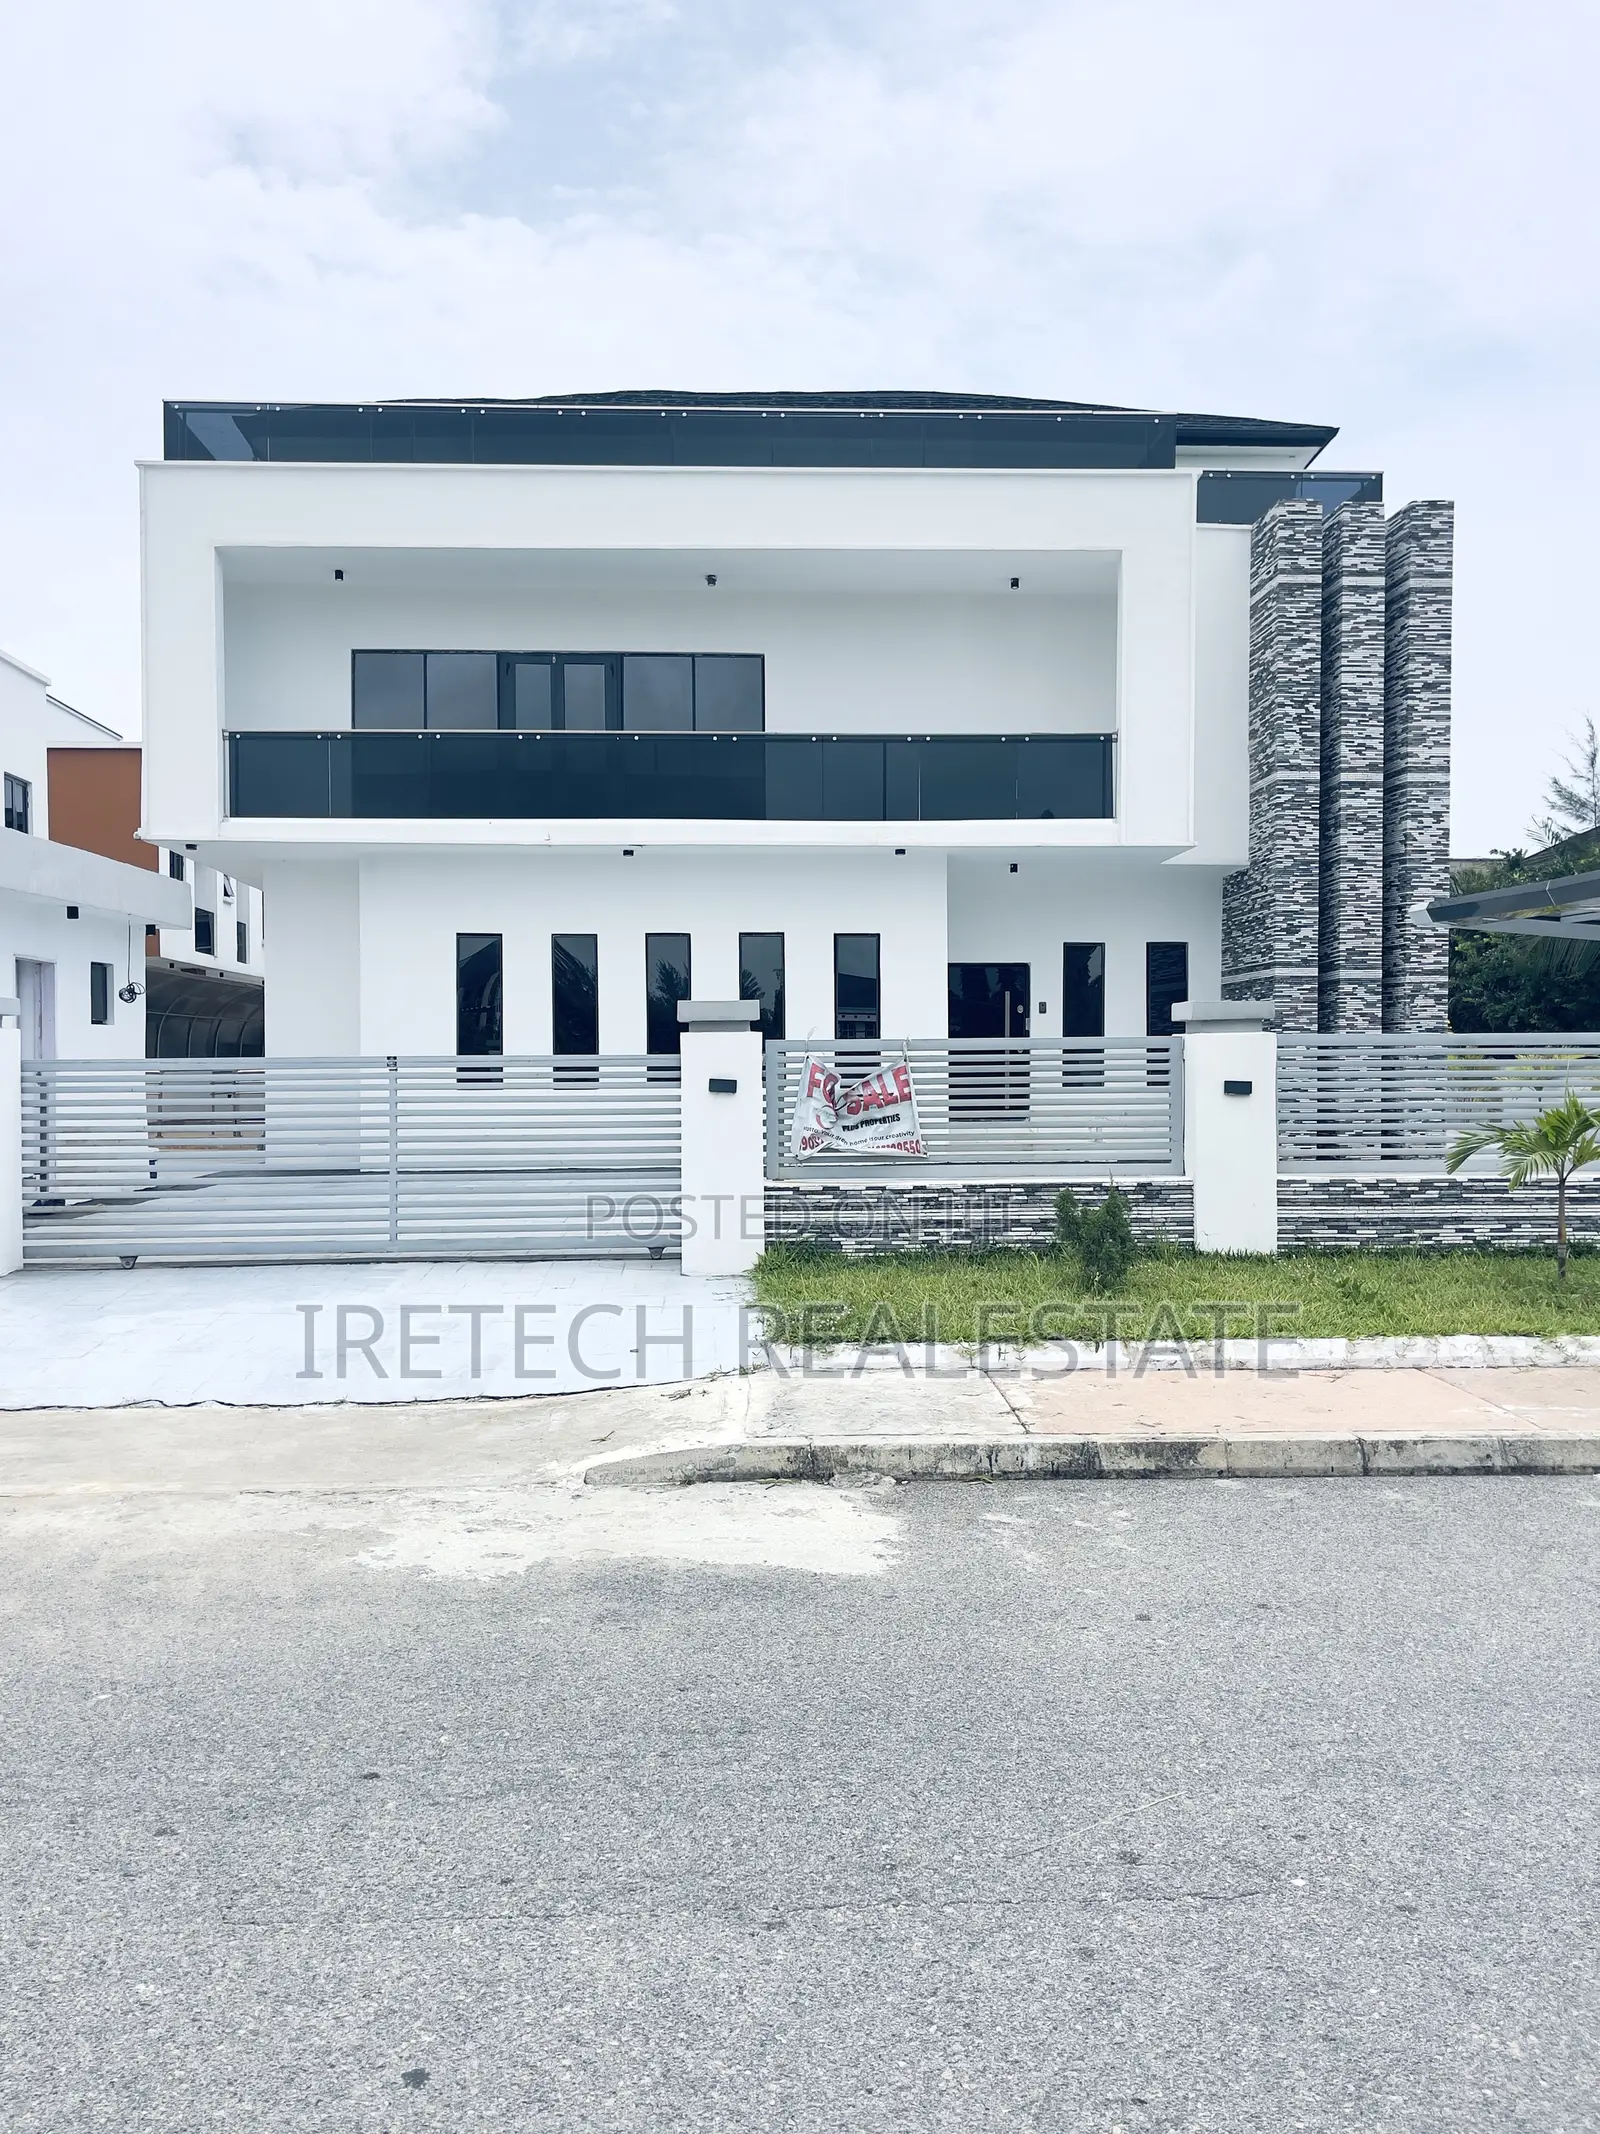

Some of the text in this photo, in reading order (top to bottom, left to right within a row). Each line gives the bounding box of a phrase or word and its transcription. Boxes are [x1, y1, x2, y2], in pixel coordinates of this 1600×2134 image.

[846, 1065, 911, 1116] SALE
[860, 1113, 901, 1129] PROPERTIES
[849, 1138, 868, 1147] home
[885, 1130, 915, 1140] creativity
